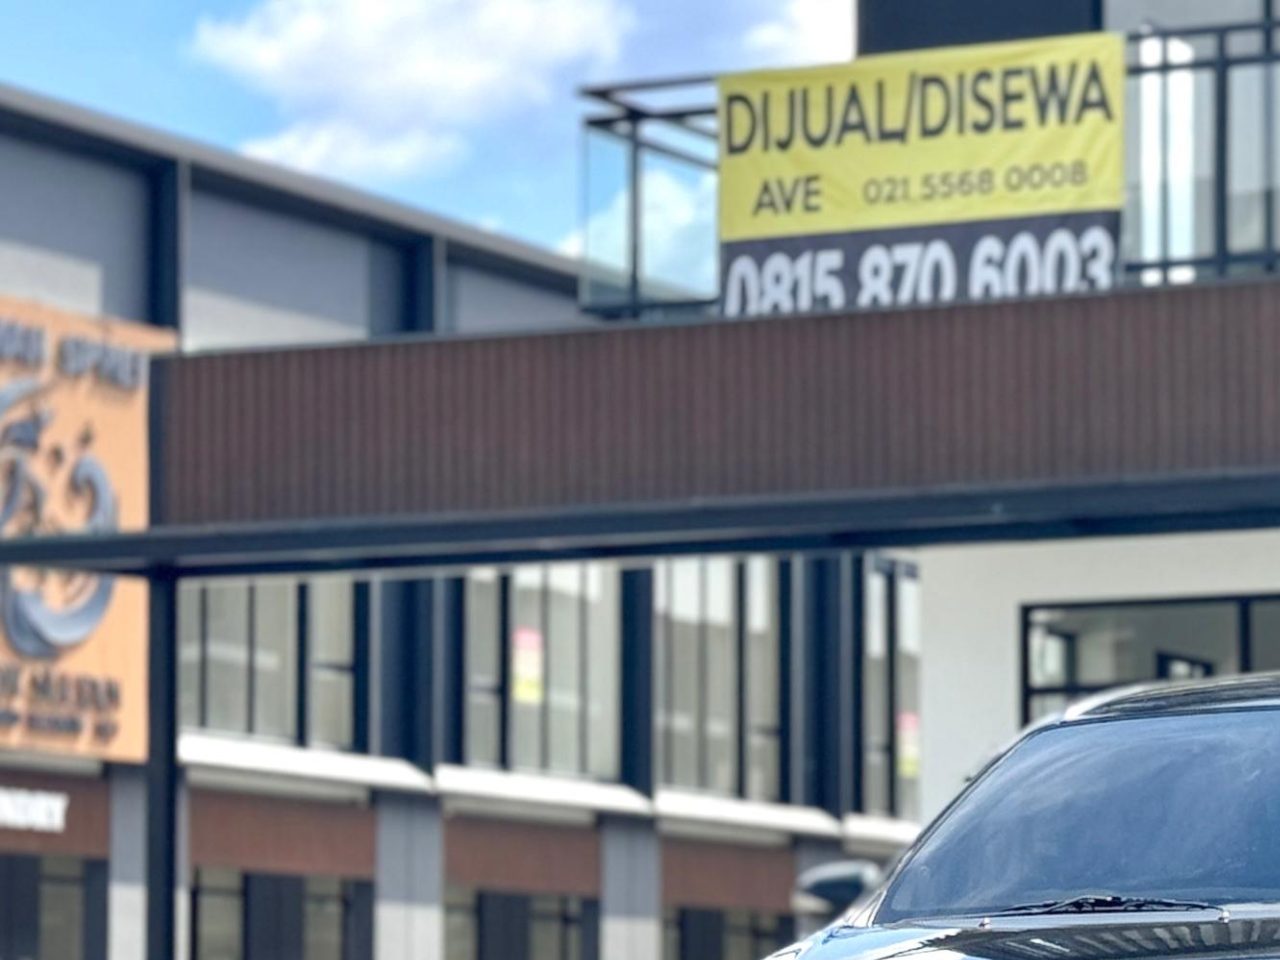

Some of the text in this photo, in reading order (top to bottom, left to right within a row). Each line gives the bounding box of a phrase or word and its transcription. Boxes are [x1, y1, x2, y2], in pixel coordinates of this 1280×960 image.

[726, 60, 1114, 156] DIJUAL/DISEWA
[753, 174, 822, 217] AVE
[1004, 159, 1089, 194] 0008
[725, 225, 1116, 318] 0815 870 6003
